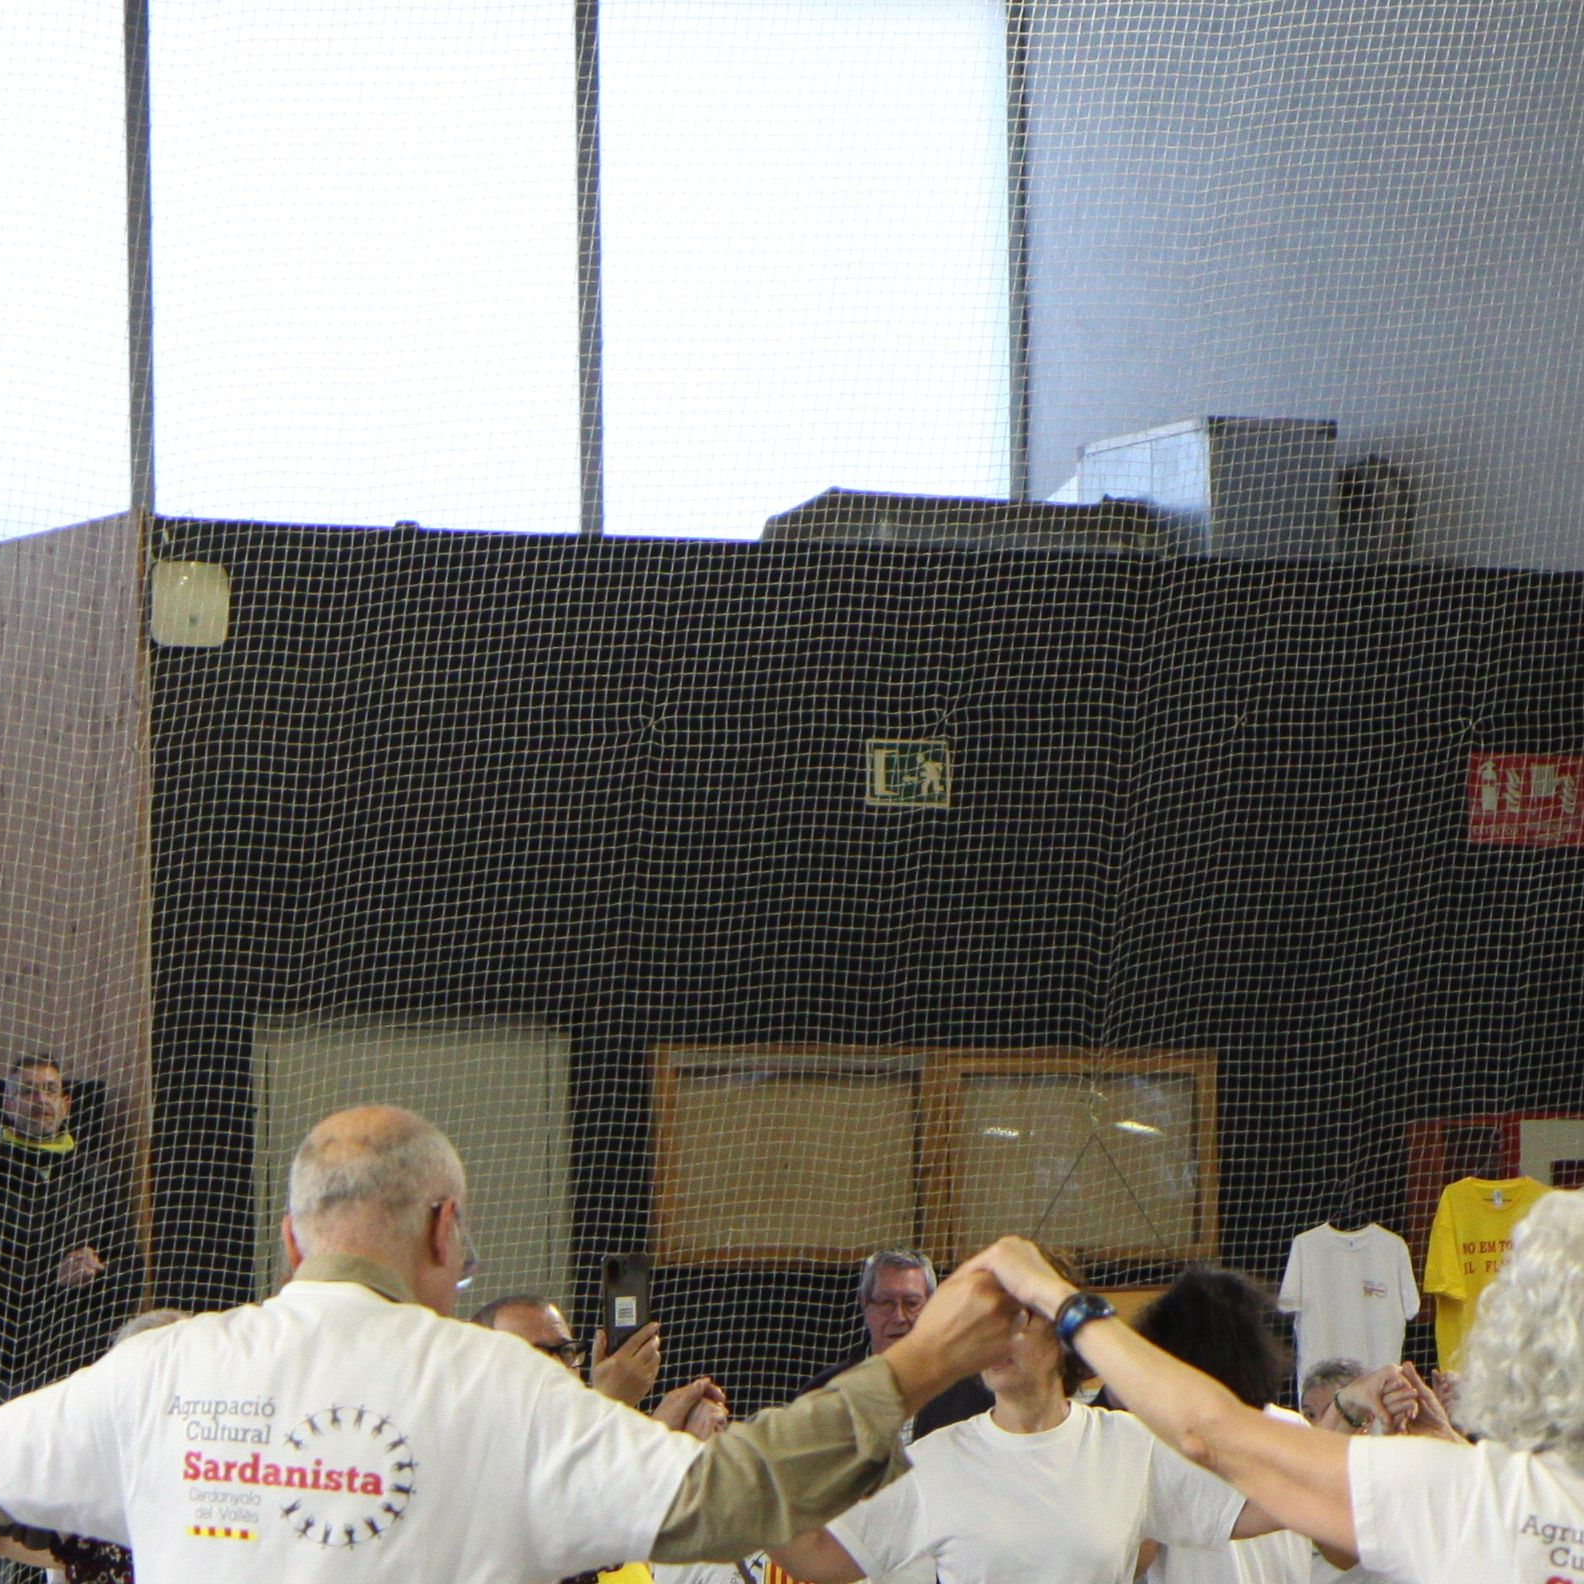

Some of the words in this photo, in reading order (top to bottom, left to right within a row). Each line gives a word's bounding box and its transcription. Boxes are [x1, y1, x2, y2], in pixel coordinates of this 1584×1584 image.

[1480, 1240, 1497, 1253] EM
[168, 1395, 277, 1421] Agrupació
[186, 1420, 272, 1446] Cultural
[182, 1450, 384, 1496] Sardanista
[188, 1486, 262, 1506] Cerdanyola
[194, 1506, 213, 1520] del
